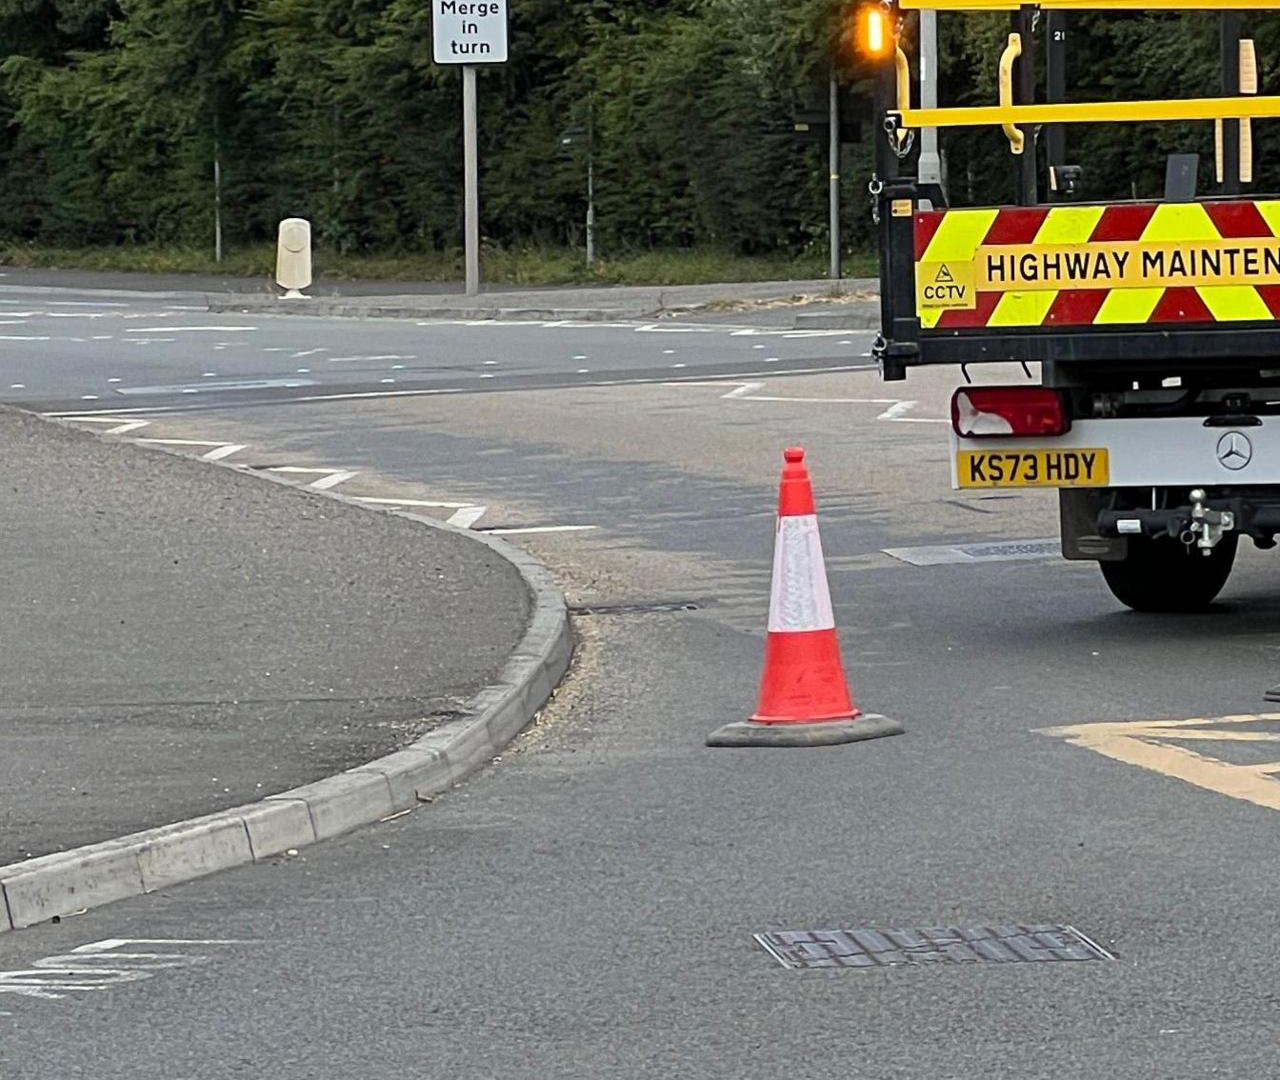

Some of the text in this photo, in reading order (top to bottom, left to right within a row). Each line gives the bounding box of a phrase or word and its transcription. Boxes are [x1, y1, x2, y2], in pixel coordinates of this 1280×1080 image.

[440, 0, 500, 17] Merge
[462, 20, 478, 34] in
[450, 39, 491, 55] turn
[986, 250, 1130, 282] HIGHWAY
[923, 284, 966, 299] CCTV
[970, 452, 1096, 482] KS73 HDY
